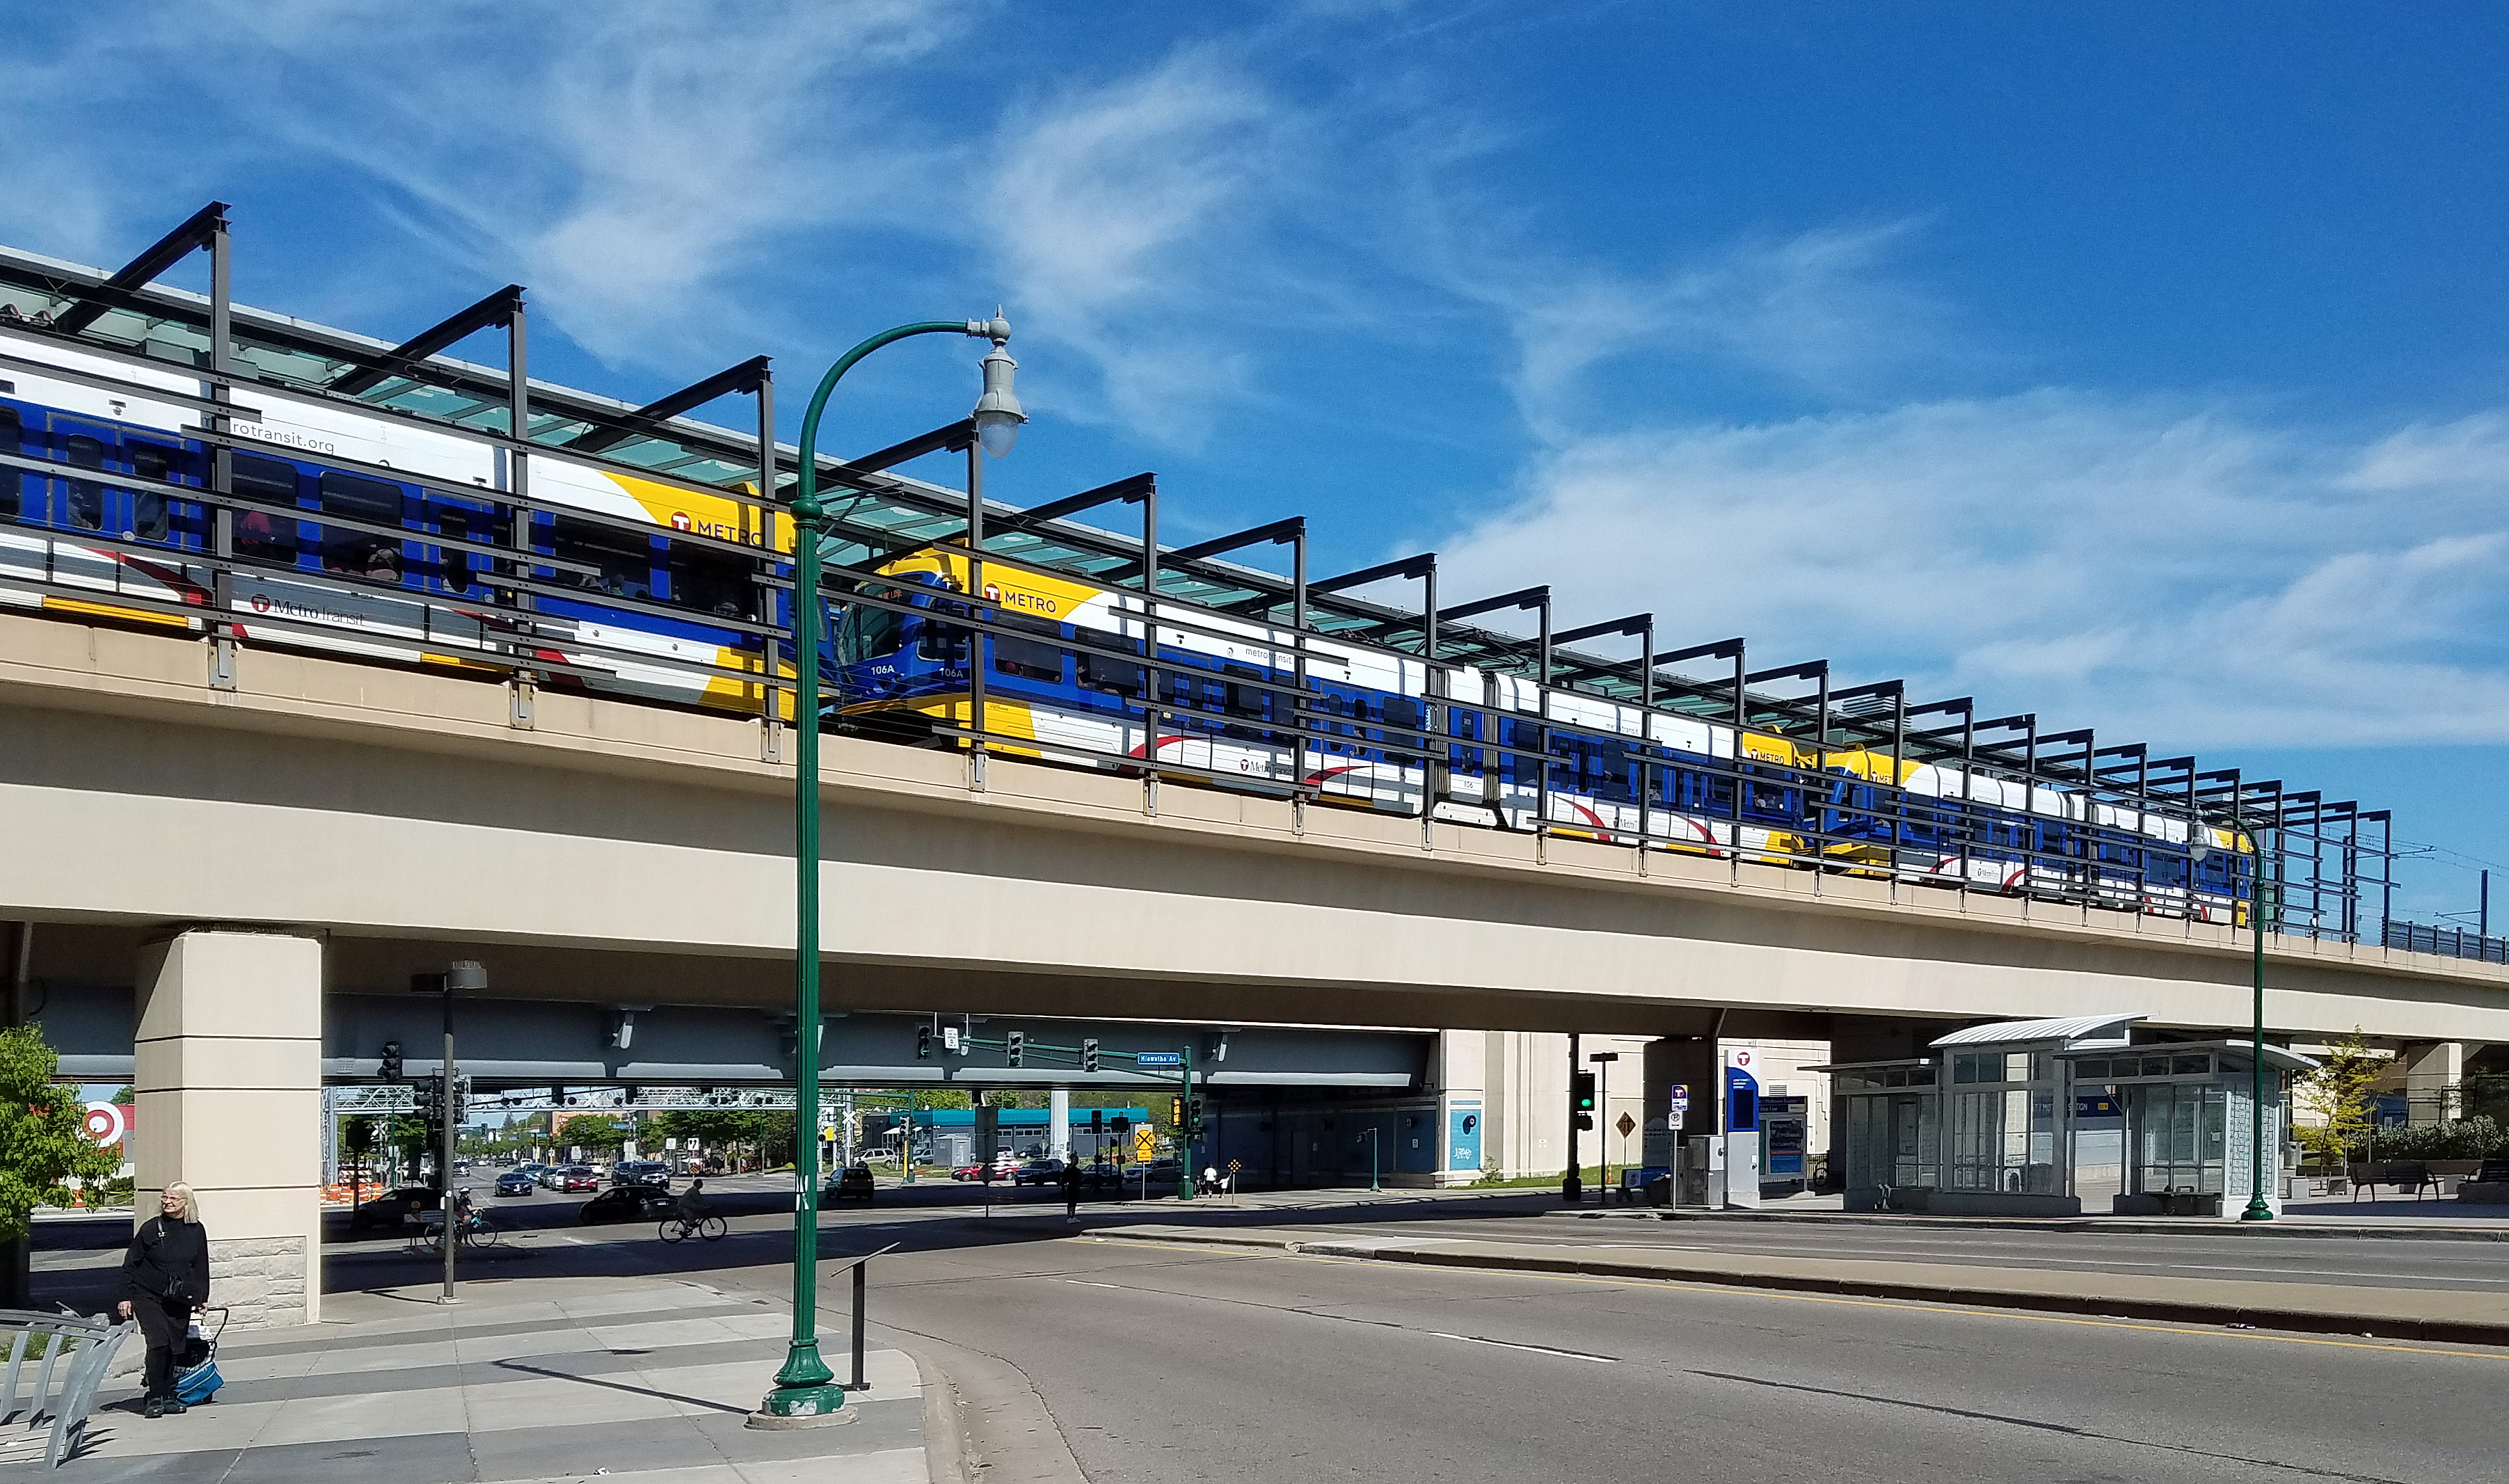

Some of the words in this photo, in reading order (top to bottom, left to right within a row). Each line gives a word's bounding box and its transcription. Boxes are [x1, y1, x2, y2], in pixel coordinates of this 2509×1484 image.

[230, 422, 334, 455] rotransit.org
[697, 519, 763, 547] METRO
[1005, 589, 1056, 613] METRO
[274, 599, 319, 619] Metro
[322, 607, 365, 626] Transit
[870, 664, 895, 676] 106A
[939, 667, 964, 678] 106A
[1760, 751, 1785, 765] METRO
[1879, 774, 1893, 784] MET
